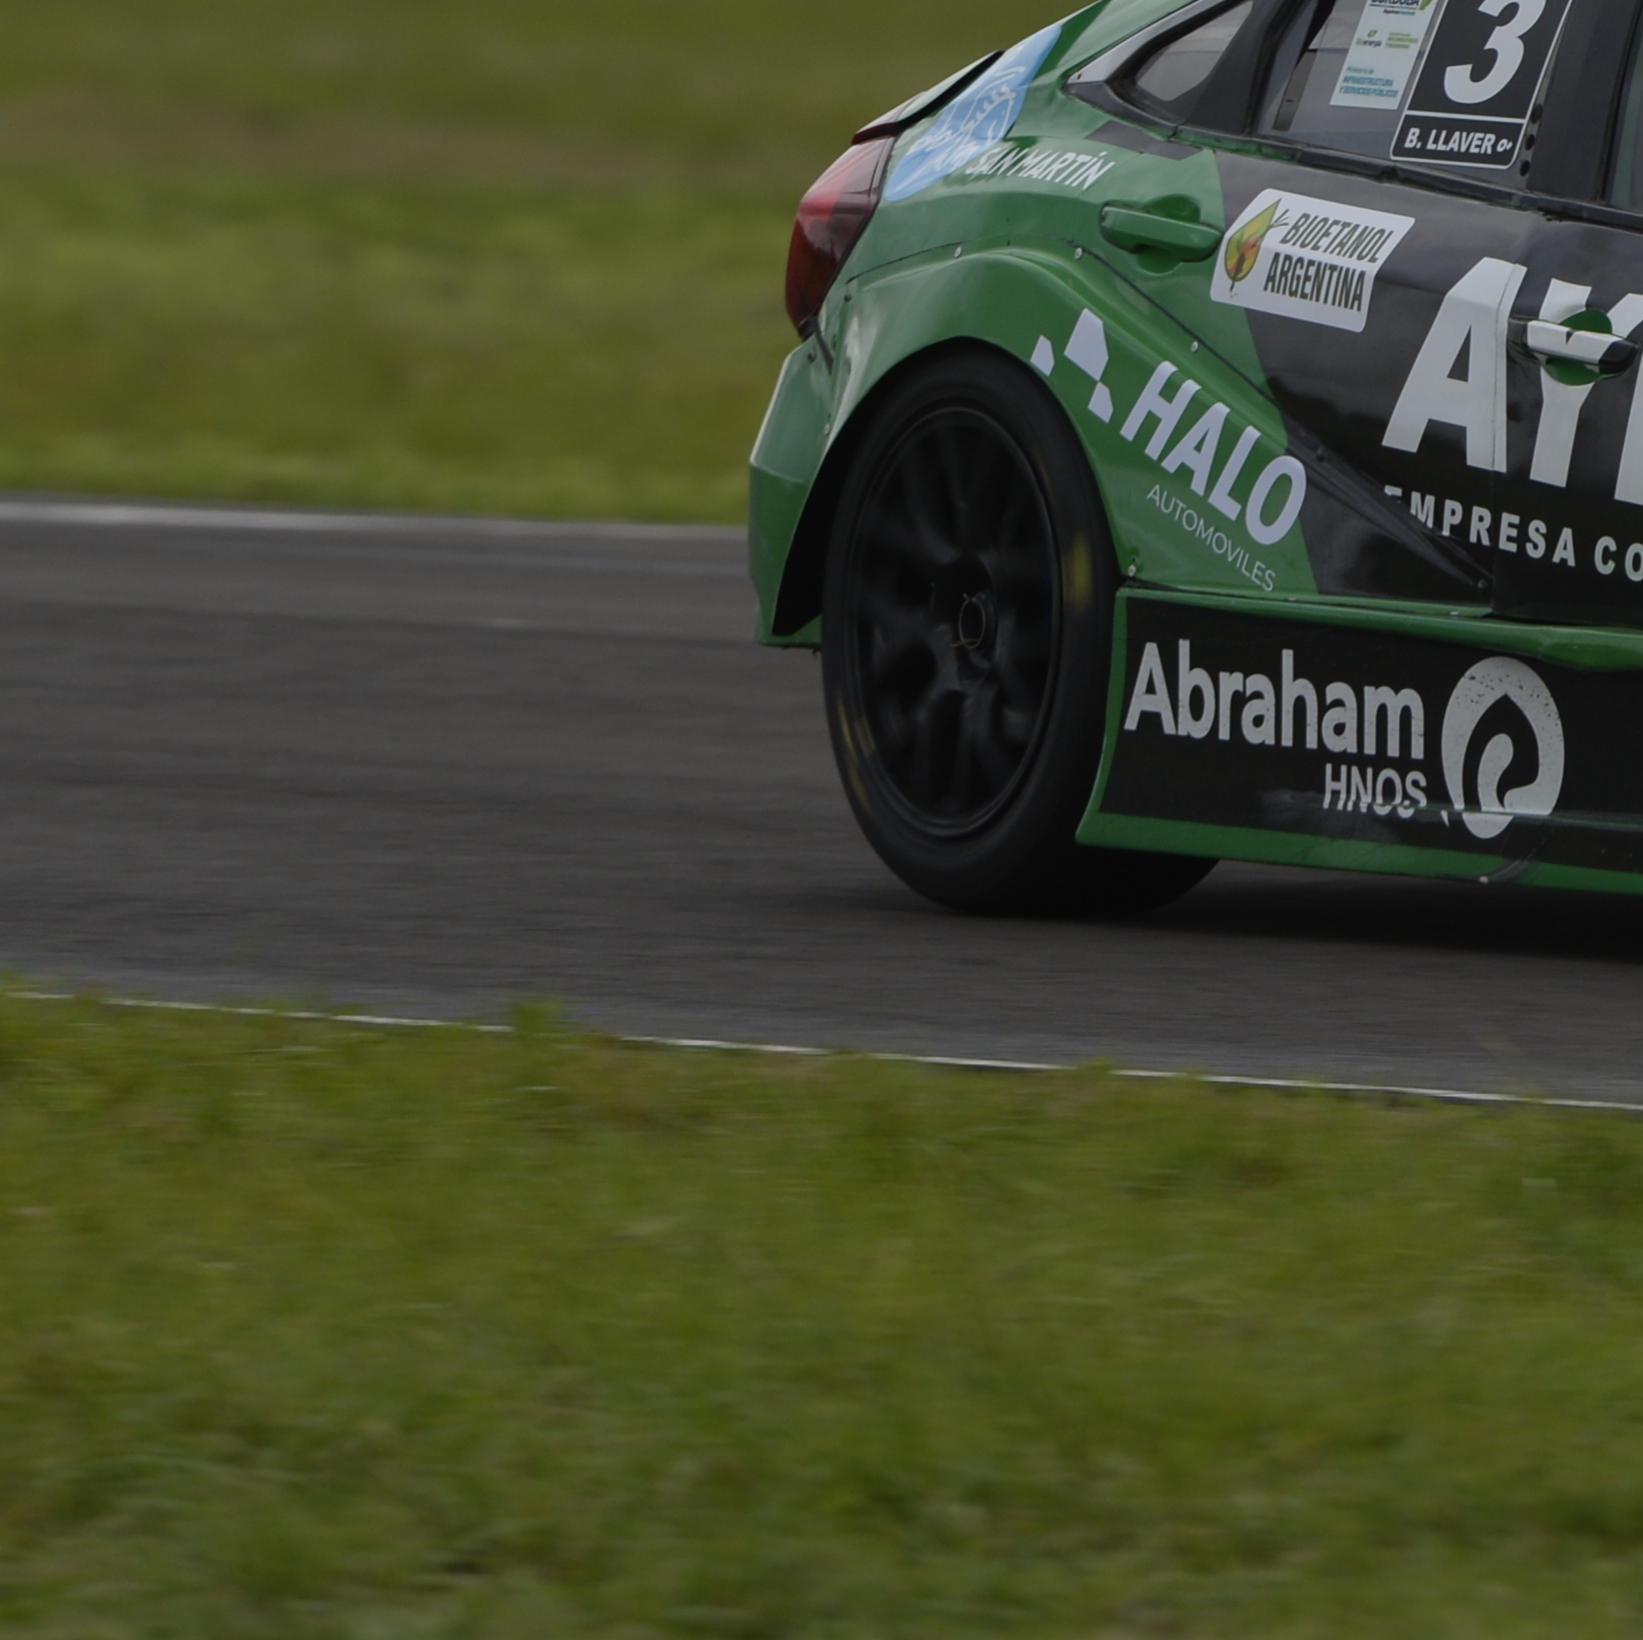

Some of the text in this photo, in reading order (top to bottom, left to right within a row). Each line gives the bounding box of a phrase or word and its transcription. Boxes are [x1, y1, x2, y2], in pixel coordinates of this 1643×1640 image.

[965, 146, 1116, 190] SAN MARTÍN
[1404, 127, 1422, 148] B.
[1426, 129, 1496, 155] LLAVER
[1279, 212, 1394, 264] BIOETANOL
[1263, 251, 1367, 312] ARGENTINA
[1119, 361, 1307, 545] HALO
[1146, 483, 1277, 592] AUTOMOVILES
[1123, 638, 1426, 760] Abraham
[1321, 762, 1428, 819] HNOS
